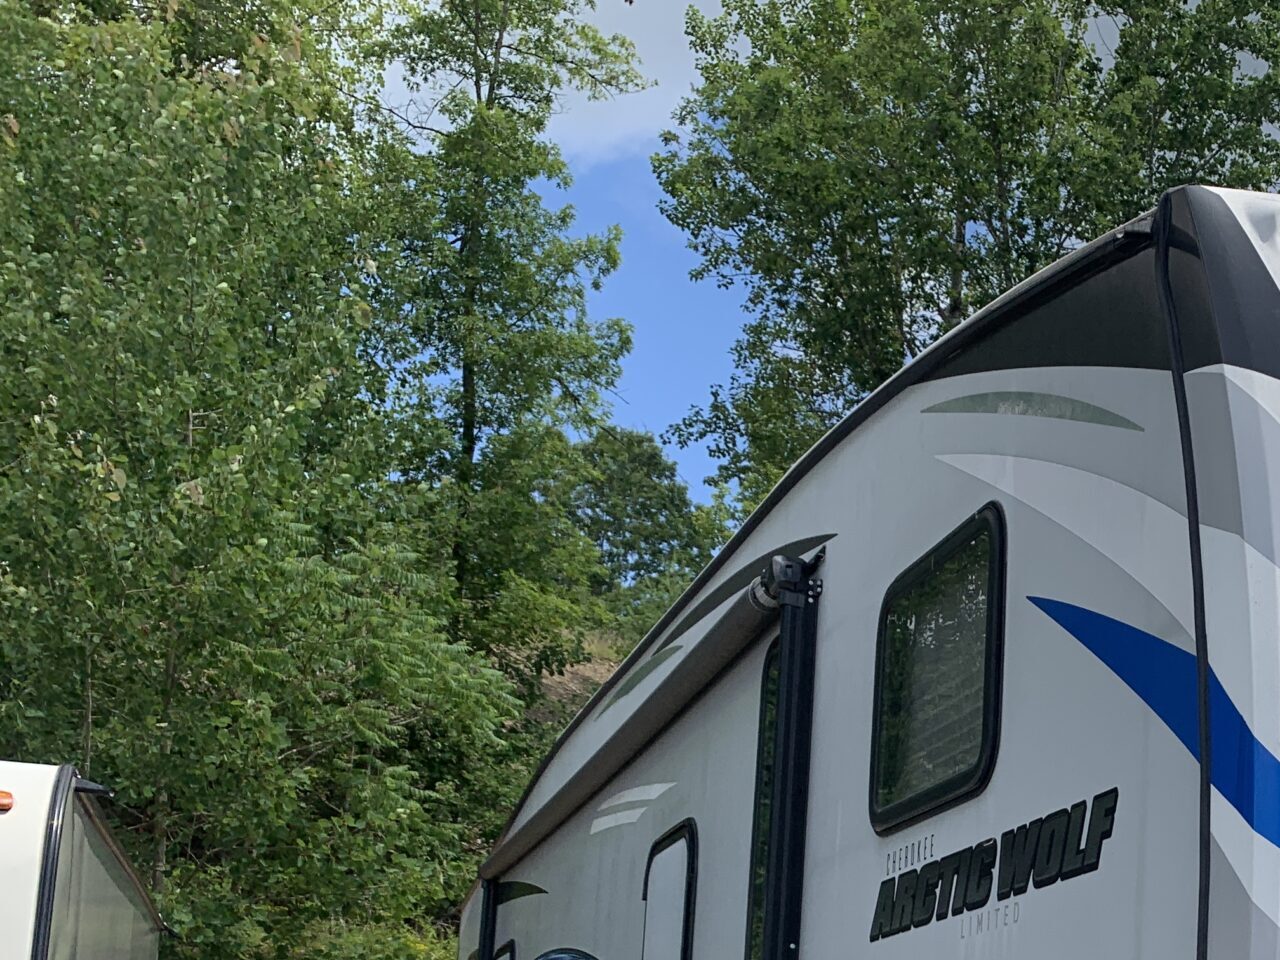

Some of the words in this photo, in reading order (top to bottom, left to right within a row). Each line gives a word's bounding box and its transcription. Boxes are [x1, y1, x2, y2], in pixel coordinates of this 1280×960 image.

[869, 837, 998, 942] ARCTIC
[997, 787, 1119, 902] WOLF
[886, 834, 935, 876] CHEROKEE
[960, 902, 1021, 939] LIMITED
